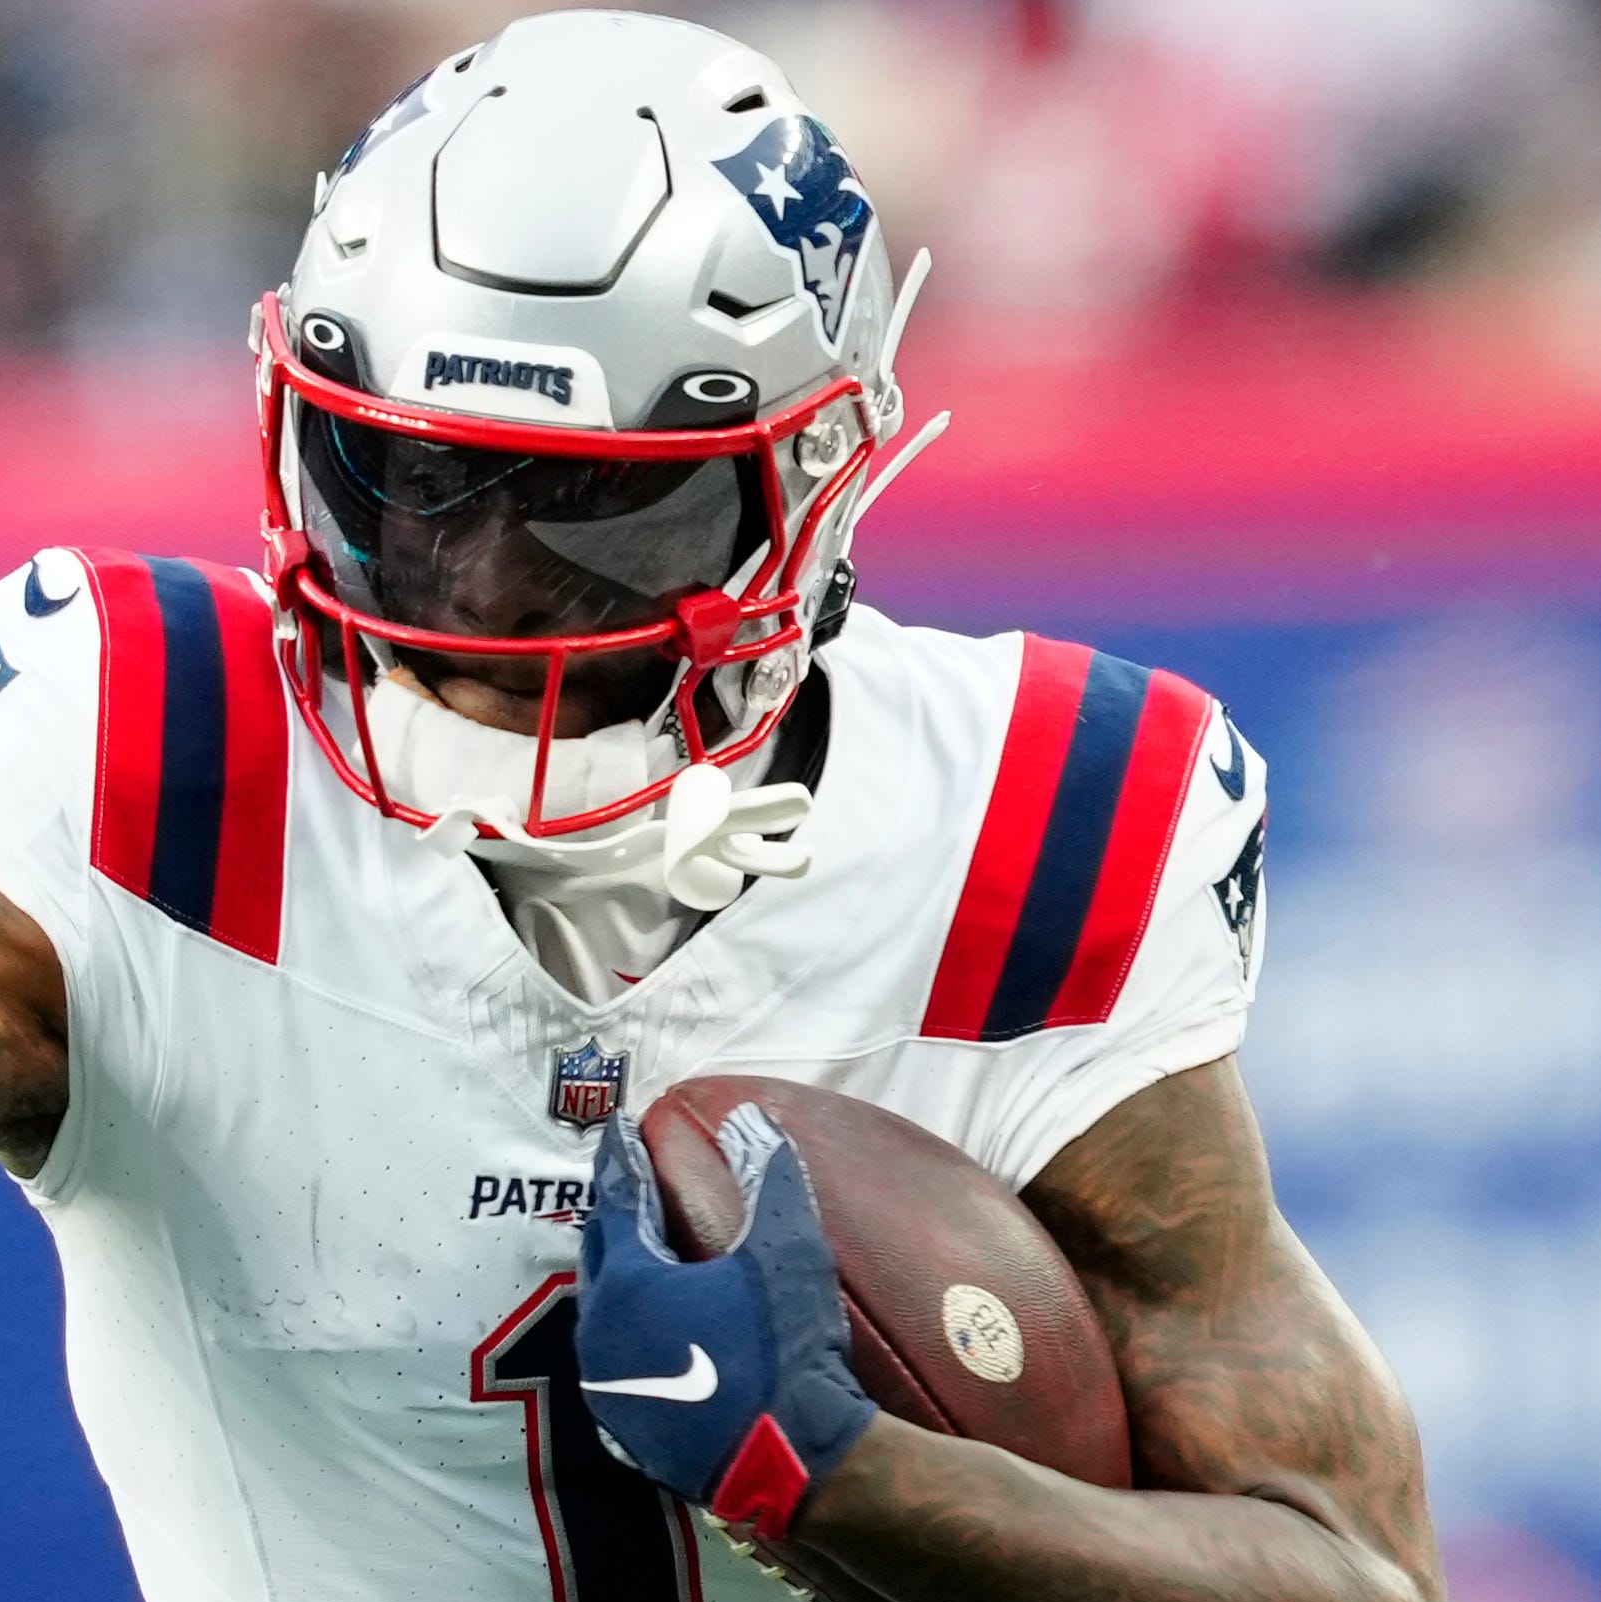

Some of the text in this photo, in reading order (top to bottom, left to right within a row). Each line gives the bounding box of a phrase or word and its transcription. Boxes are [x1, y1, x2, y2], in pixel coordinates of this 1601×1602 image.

[424, 351, 574, 406] PATRIOTS
[561, 1083, 615, 1119] NFL
[469, 1174, 597, 1220] PATRI
